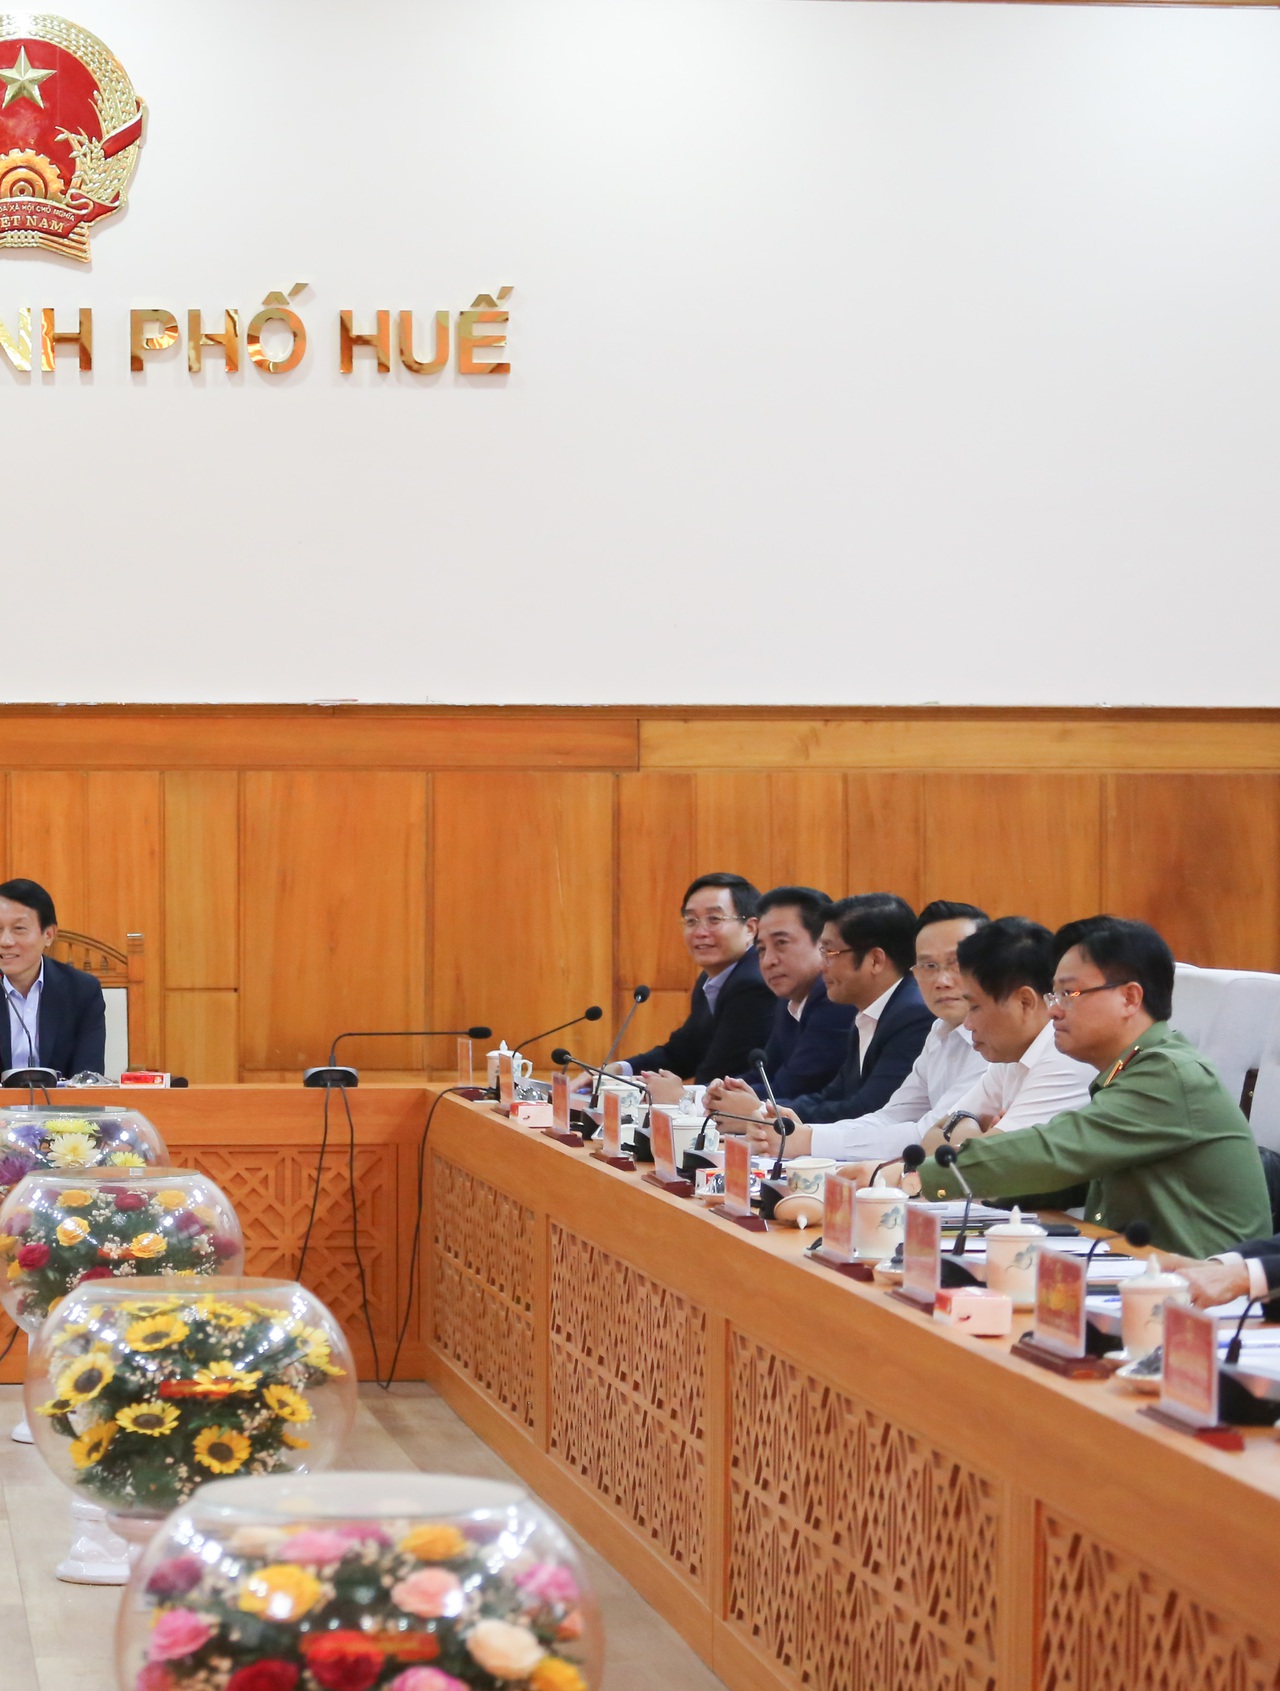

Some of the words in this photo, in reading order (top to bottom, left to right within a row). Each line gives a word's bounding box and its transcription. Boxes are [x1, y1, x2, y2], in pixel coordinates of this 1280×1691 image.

[26, 216, 64, 232] NAM
[130, 282, 310, 374] PHỐ
[339, 286, 514, 375] HUẾ
